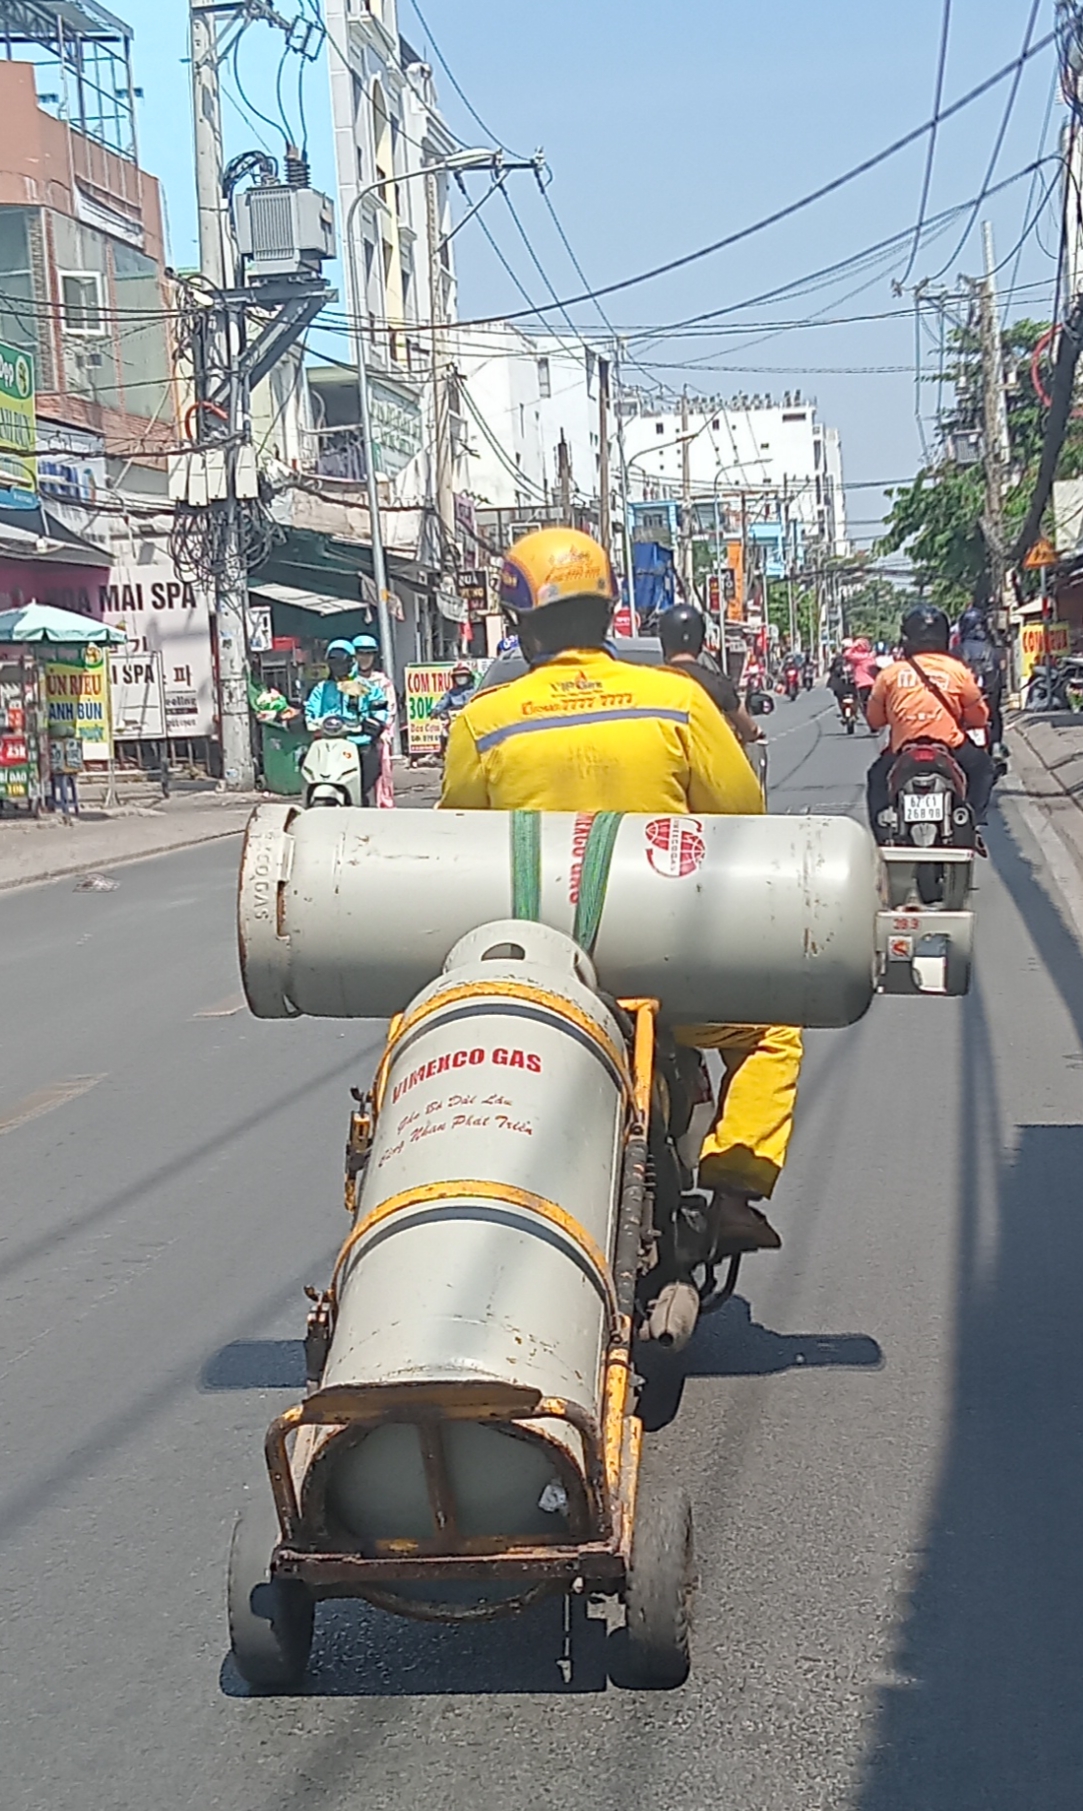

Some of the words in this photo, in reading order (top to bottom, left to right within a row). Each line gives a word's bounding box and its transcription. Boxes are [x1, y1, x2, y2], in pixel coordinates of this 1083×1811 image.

[100, 583, 143, 612] MAI
[151, 582, 197, 610] SPA
[123, 664, 155, 684] SPA
[78, 699, 102, 720] BÚN
[492, 1048, 541, 1073] GAS
